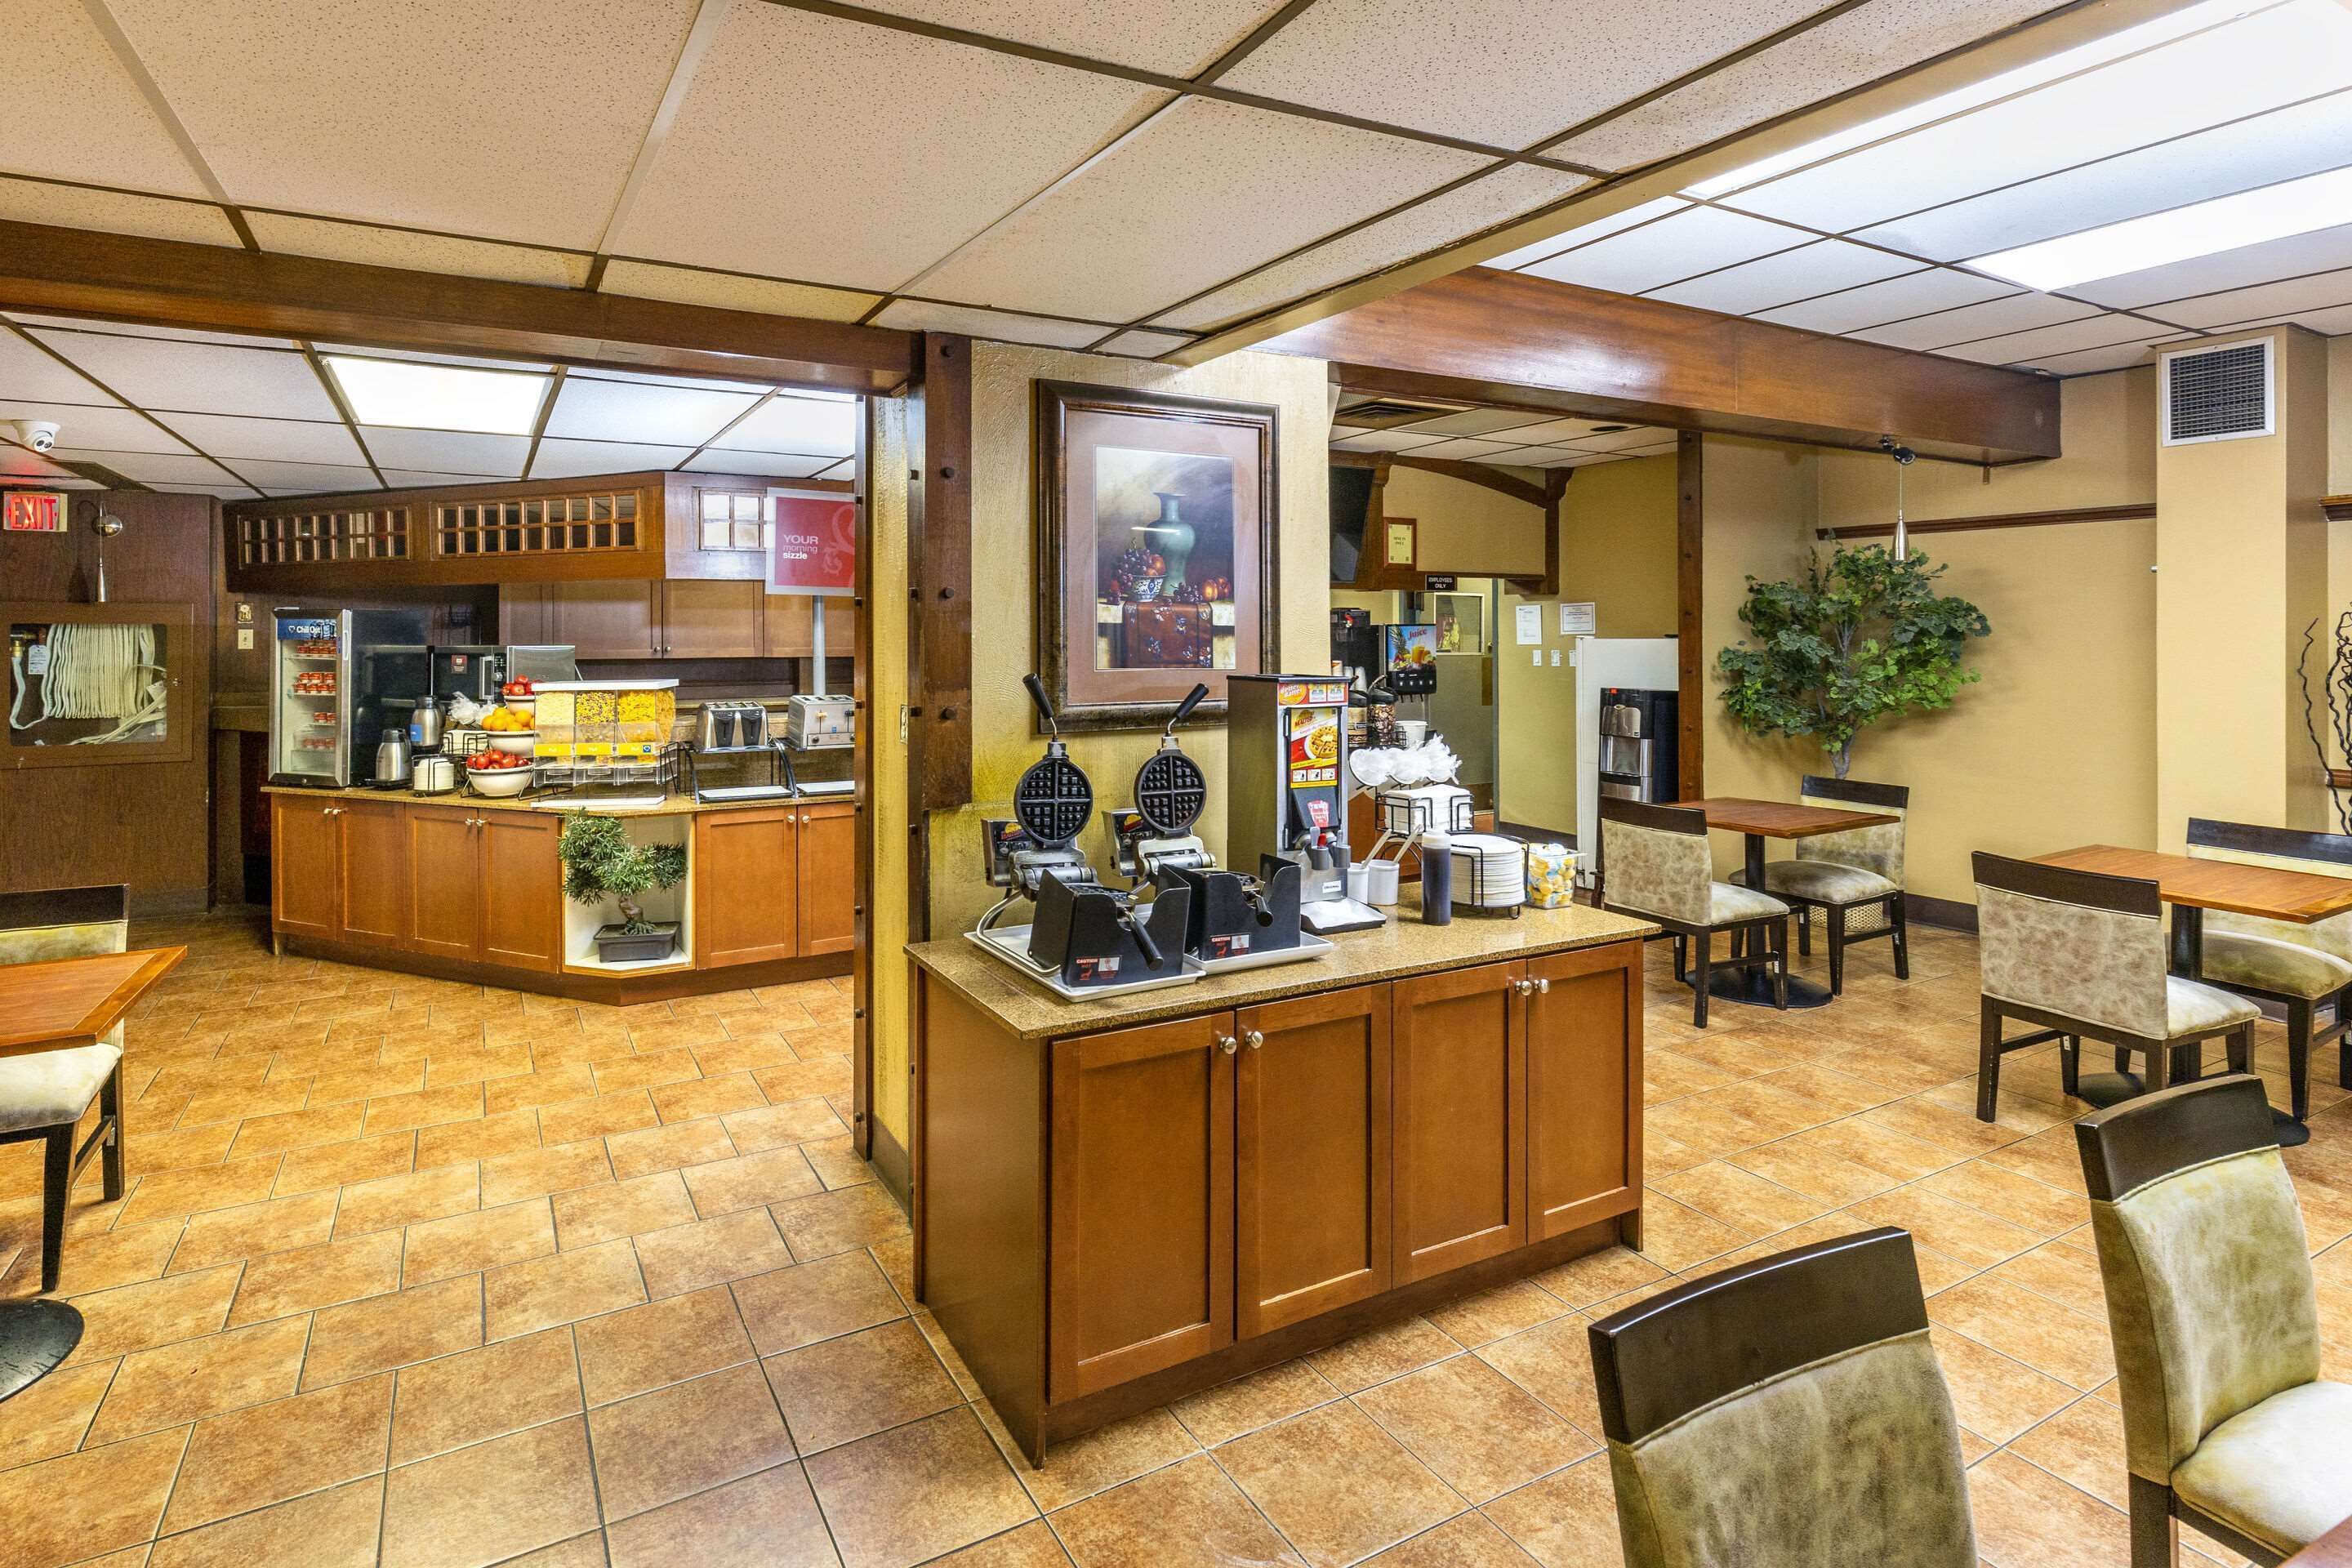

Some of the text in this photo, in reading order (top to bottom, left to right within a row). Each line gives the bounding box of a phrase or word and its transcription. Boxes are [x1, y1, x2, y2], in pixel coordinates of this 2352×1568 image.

[11, 497, 56, 530] EXIT
[783, 534, 819, 545] YOUR
[783, 545, 817, 555] morning
[783, 550, 808, 560] sizzle
[296, 626, 321, 634] Chill Out
